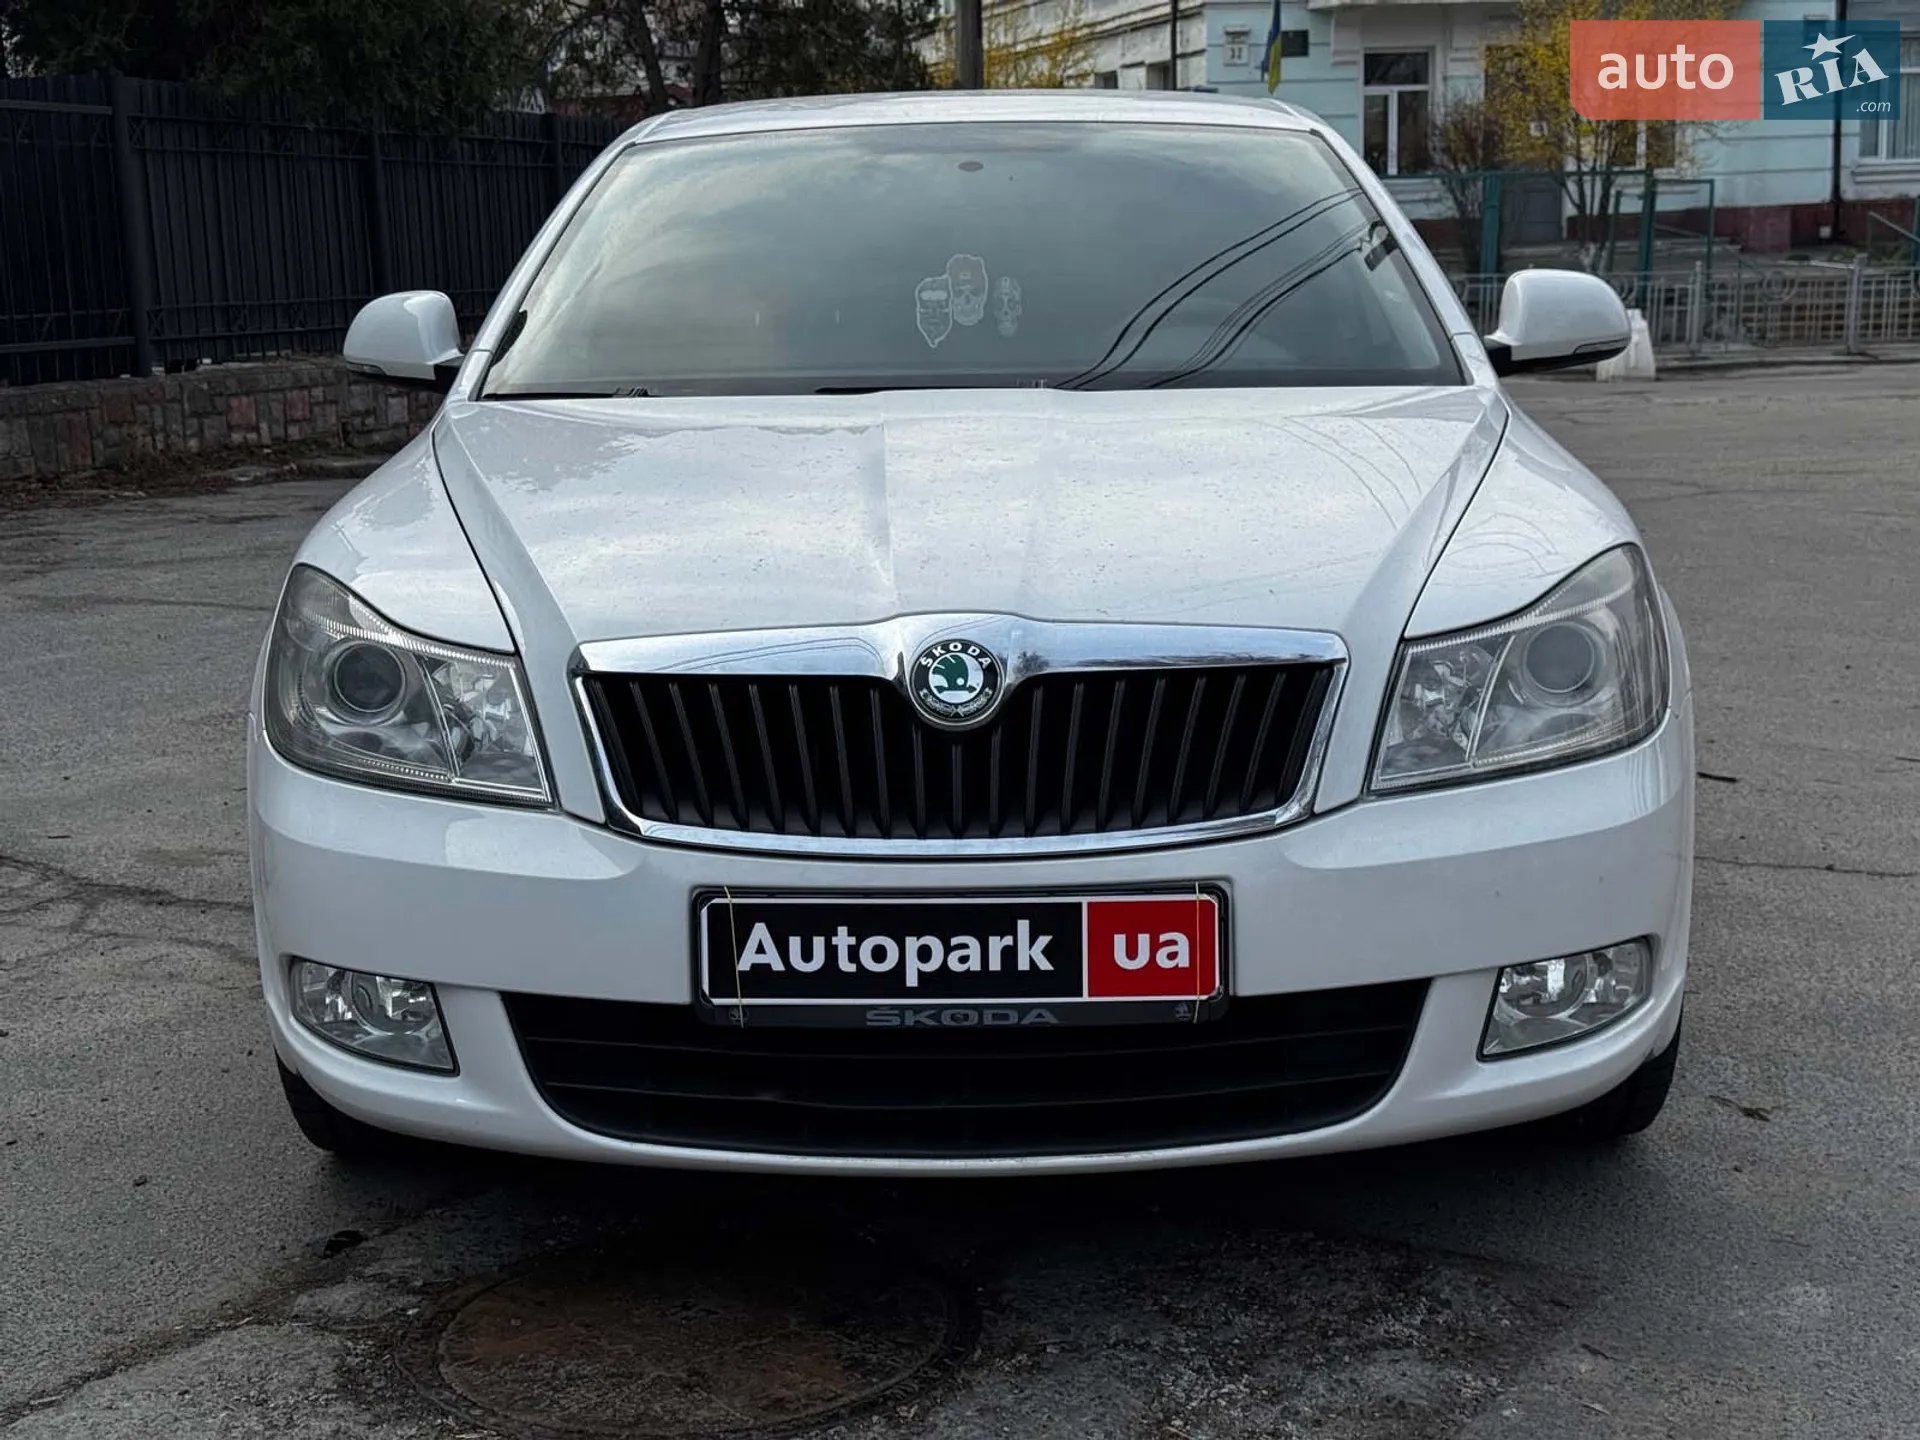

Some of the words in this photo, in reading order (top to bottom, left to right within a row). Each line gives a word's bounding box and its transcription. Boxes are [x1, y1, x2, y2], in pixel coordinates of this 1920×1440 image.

[920, 642, 993, 669] SKODA
[737, 919, 1054, 988] Autopark
[1112, 930, 1191, 970] ua
